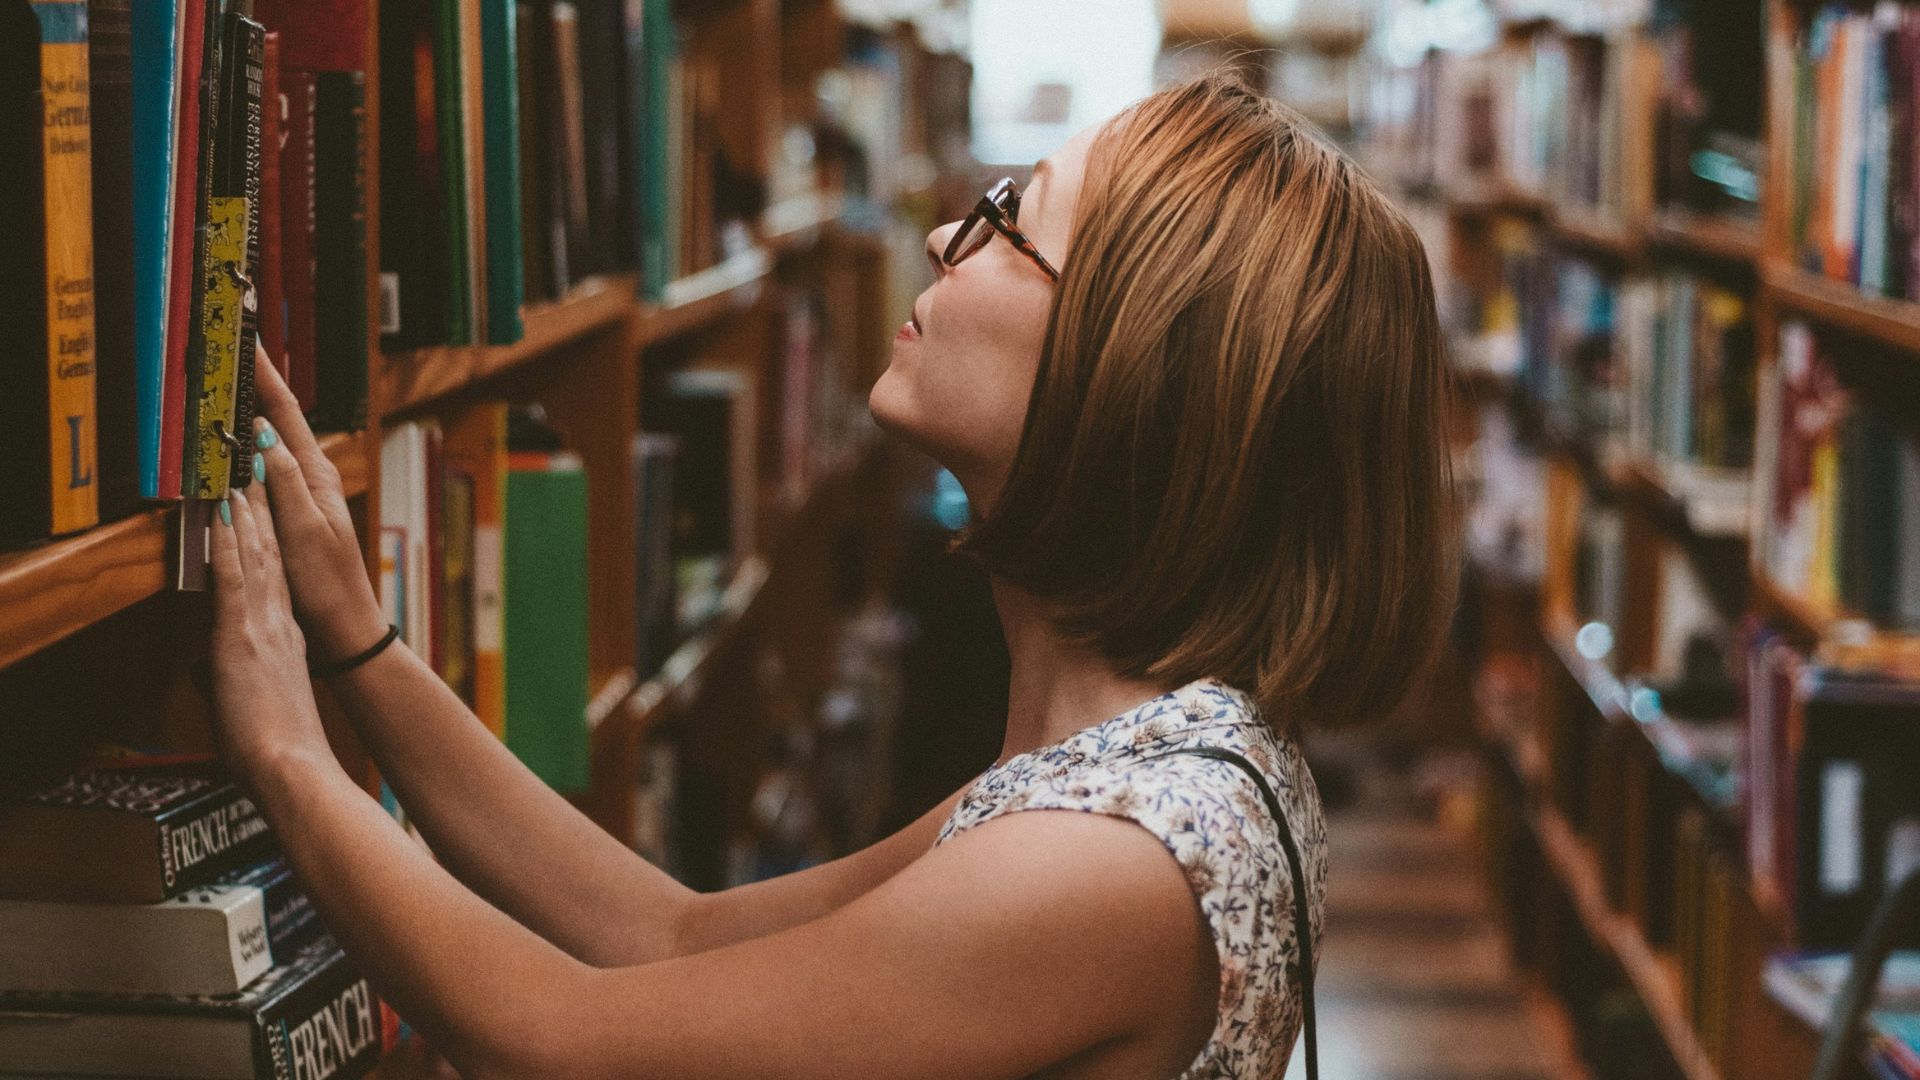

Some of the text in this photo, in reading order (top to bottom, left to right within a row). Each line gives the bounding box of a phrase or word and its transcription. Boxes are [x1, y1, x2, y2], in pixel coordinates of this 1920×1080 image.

[251, 103, 261, 245] GERMAN-ENGLISH
[67, 415, 92, 490] L
[172, 807, 231, 872] FRENCH
[289, 978, 375, 1080] FRENCH
